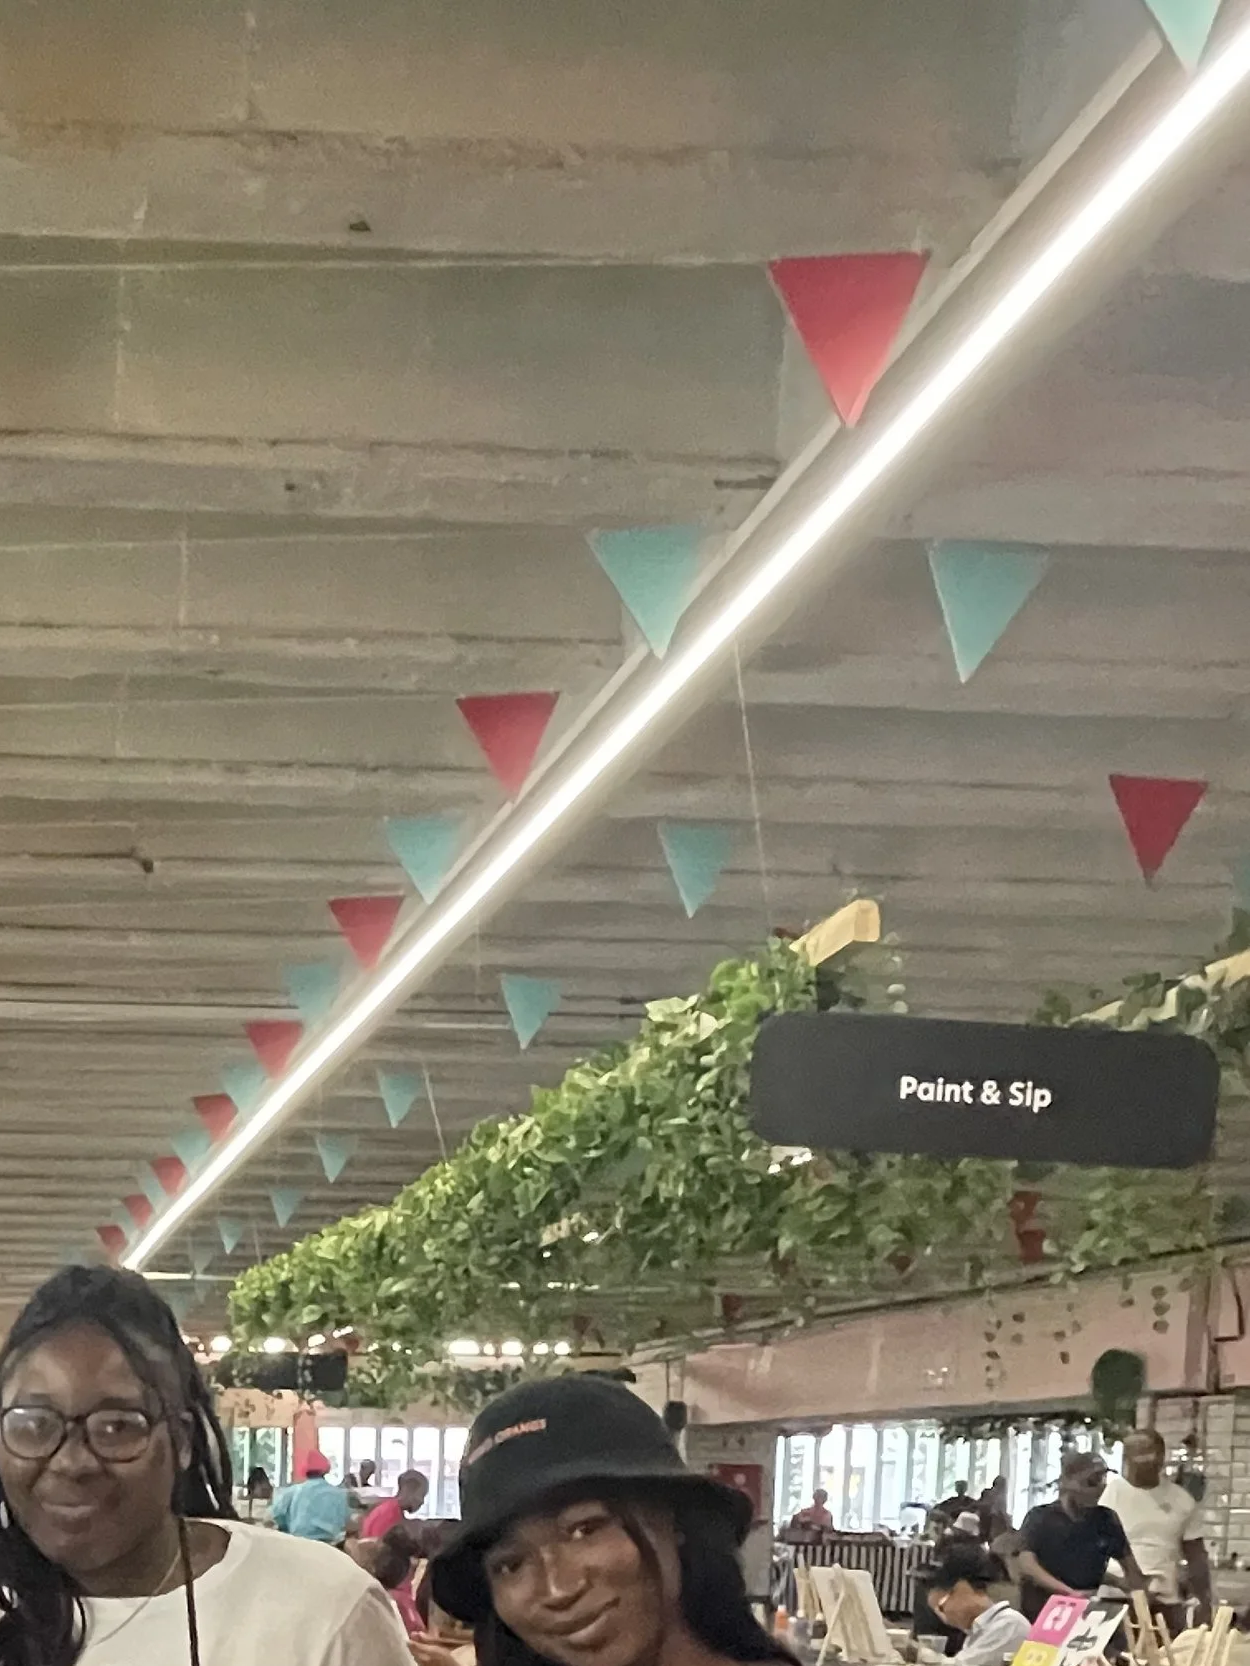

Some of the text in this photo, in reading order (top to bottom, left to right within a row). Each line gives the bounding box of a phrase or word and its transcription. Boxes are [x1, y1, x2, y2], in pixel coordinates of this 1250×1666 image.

[899, 1075, 1052, 1114] Paint & Sip
